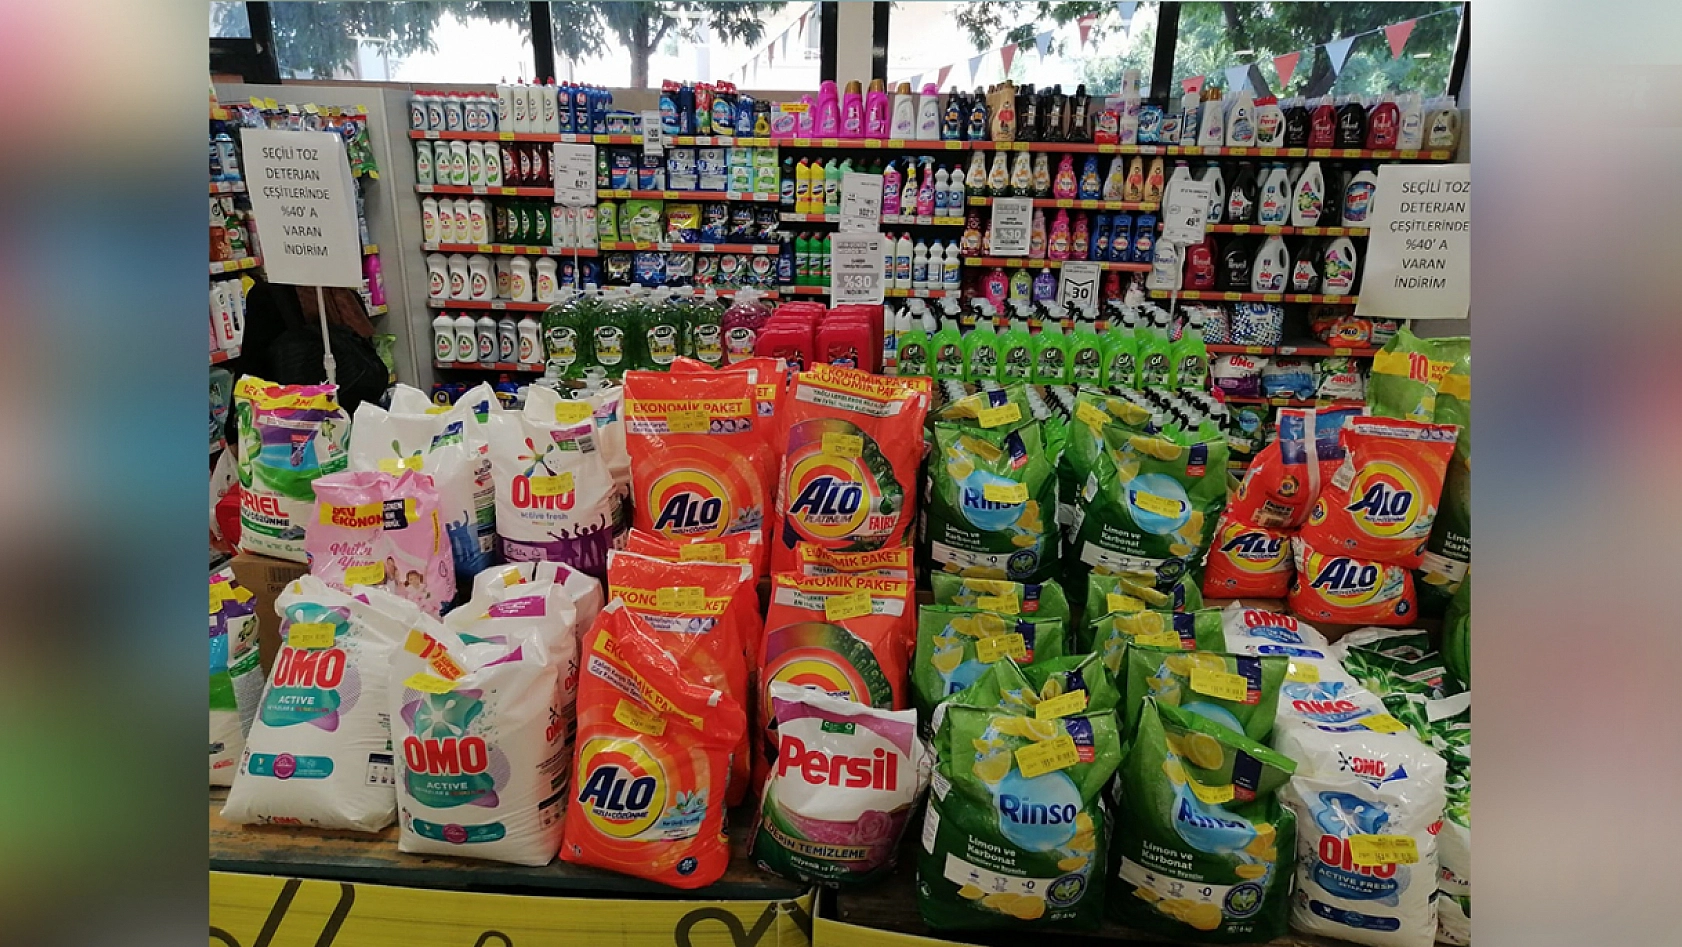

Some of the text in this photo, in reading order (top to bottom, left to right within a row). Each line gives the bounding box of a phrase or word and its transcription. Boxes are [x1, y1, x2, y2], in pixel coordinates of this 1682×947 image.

[262, 146, 318, 161] SEÇİLİ TOZ
[266, 167, 320, 181] DETERJAN
[263, 186, 330, 200] ÇEŞİTLERİNDE
[1401, 180, 1471, 195] SEÇİLİ TOZ
[310, 206, 318, 218] A
[1400, 202, 1466, 214] DETERJAN
[283, 224, 322, 238] VARAN
[1390, 219, 1470, 234] ÇEŞİTLERİNDE
[284, 243, 329, 257] İNDİRİM
[1438, 239, 1448, 251] A
[1401, 257, 1446, 270] VARAN
[1394, 272, 1447, 288] İNDİRİM
[1229, 355, 1255, 369] OMO
[703, 402, 743, 414] PAKET
[789, 478, 863, 515] ALO
[964, 486, 1021, 510] Rin
[1346, 483, 1412, 516] ALO
[653, 492, 723, 531] ALO
[1221, 532, 1285, 553] ALO
[861, 550, 902, 566] PAKET
[1311, 557, 1378, 589] ALO
[856, 578, 902, 592] PAKET
[274, 648, 347, 689] OMO
[278, 695, 315, 705] ACTIVE
[404, 736, 488, 774] OMO
[778, 733, 898, 792] Persil
[427, 781, 468, 789] ACTIVE
[579, 767, 657, 812] ALO
[1000, 794, 1077, 825] Rinso
[800, 843, 867, 859] TEMİZLEME
[968, 834, 1016, 857] Limon ve
[1142, 840, 1193, 860] Limon ve
[967, 843, 1016, 867] Karbonat
[1141, 849, 1193, 871] Karbonat
[1318, 867, 1395, 890] ACTIVE FRESH
